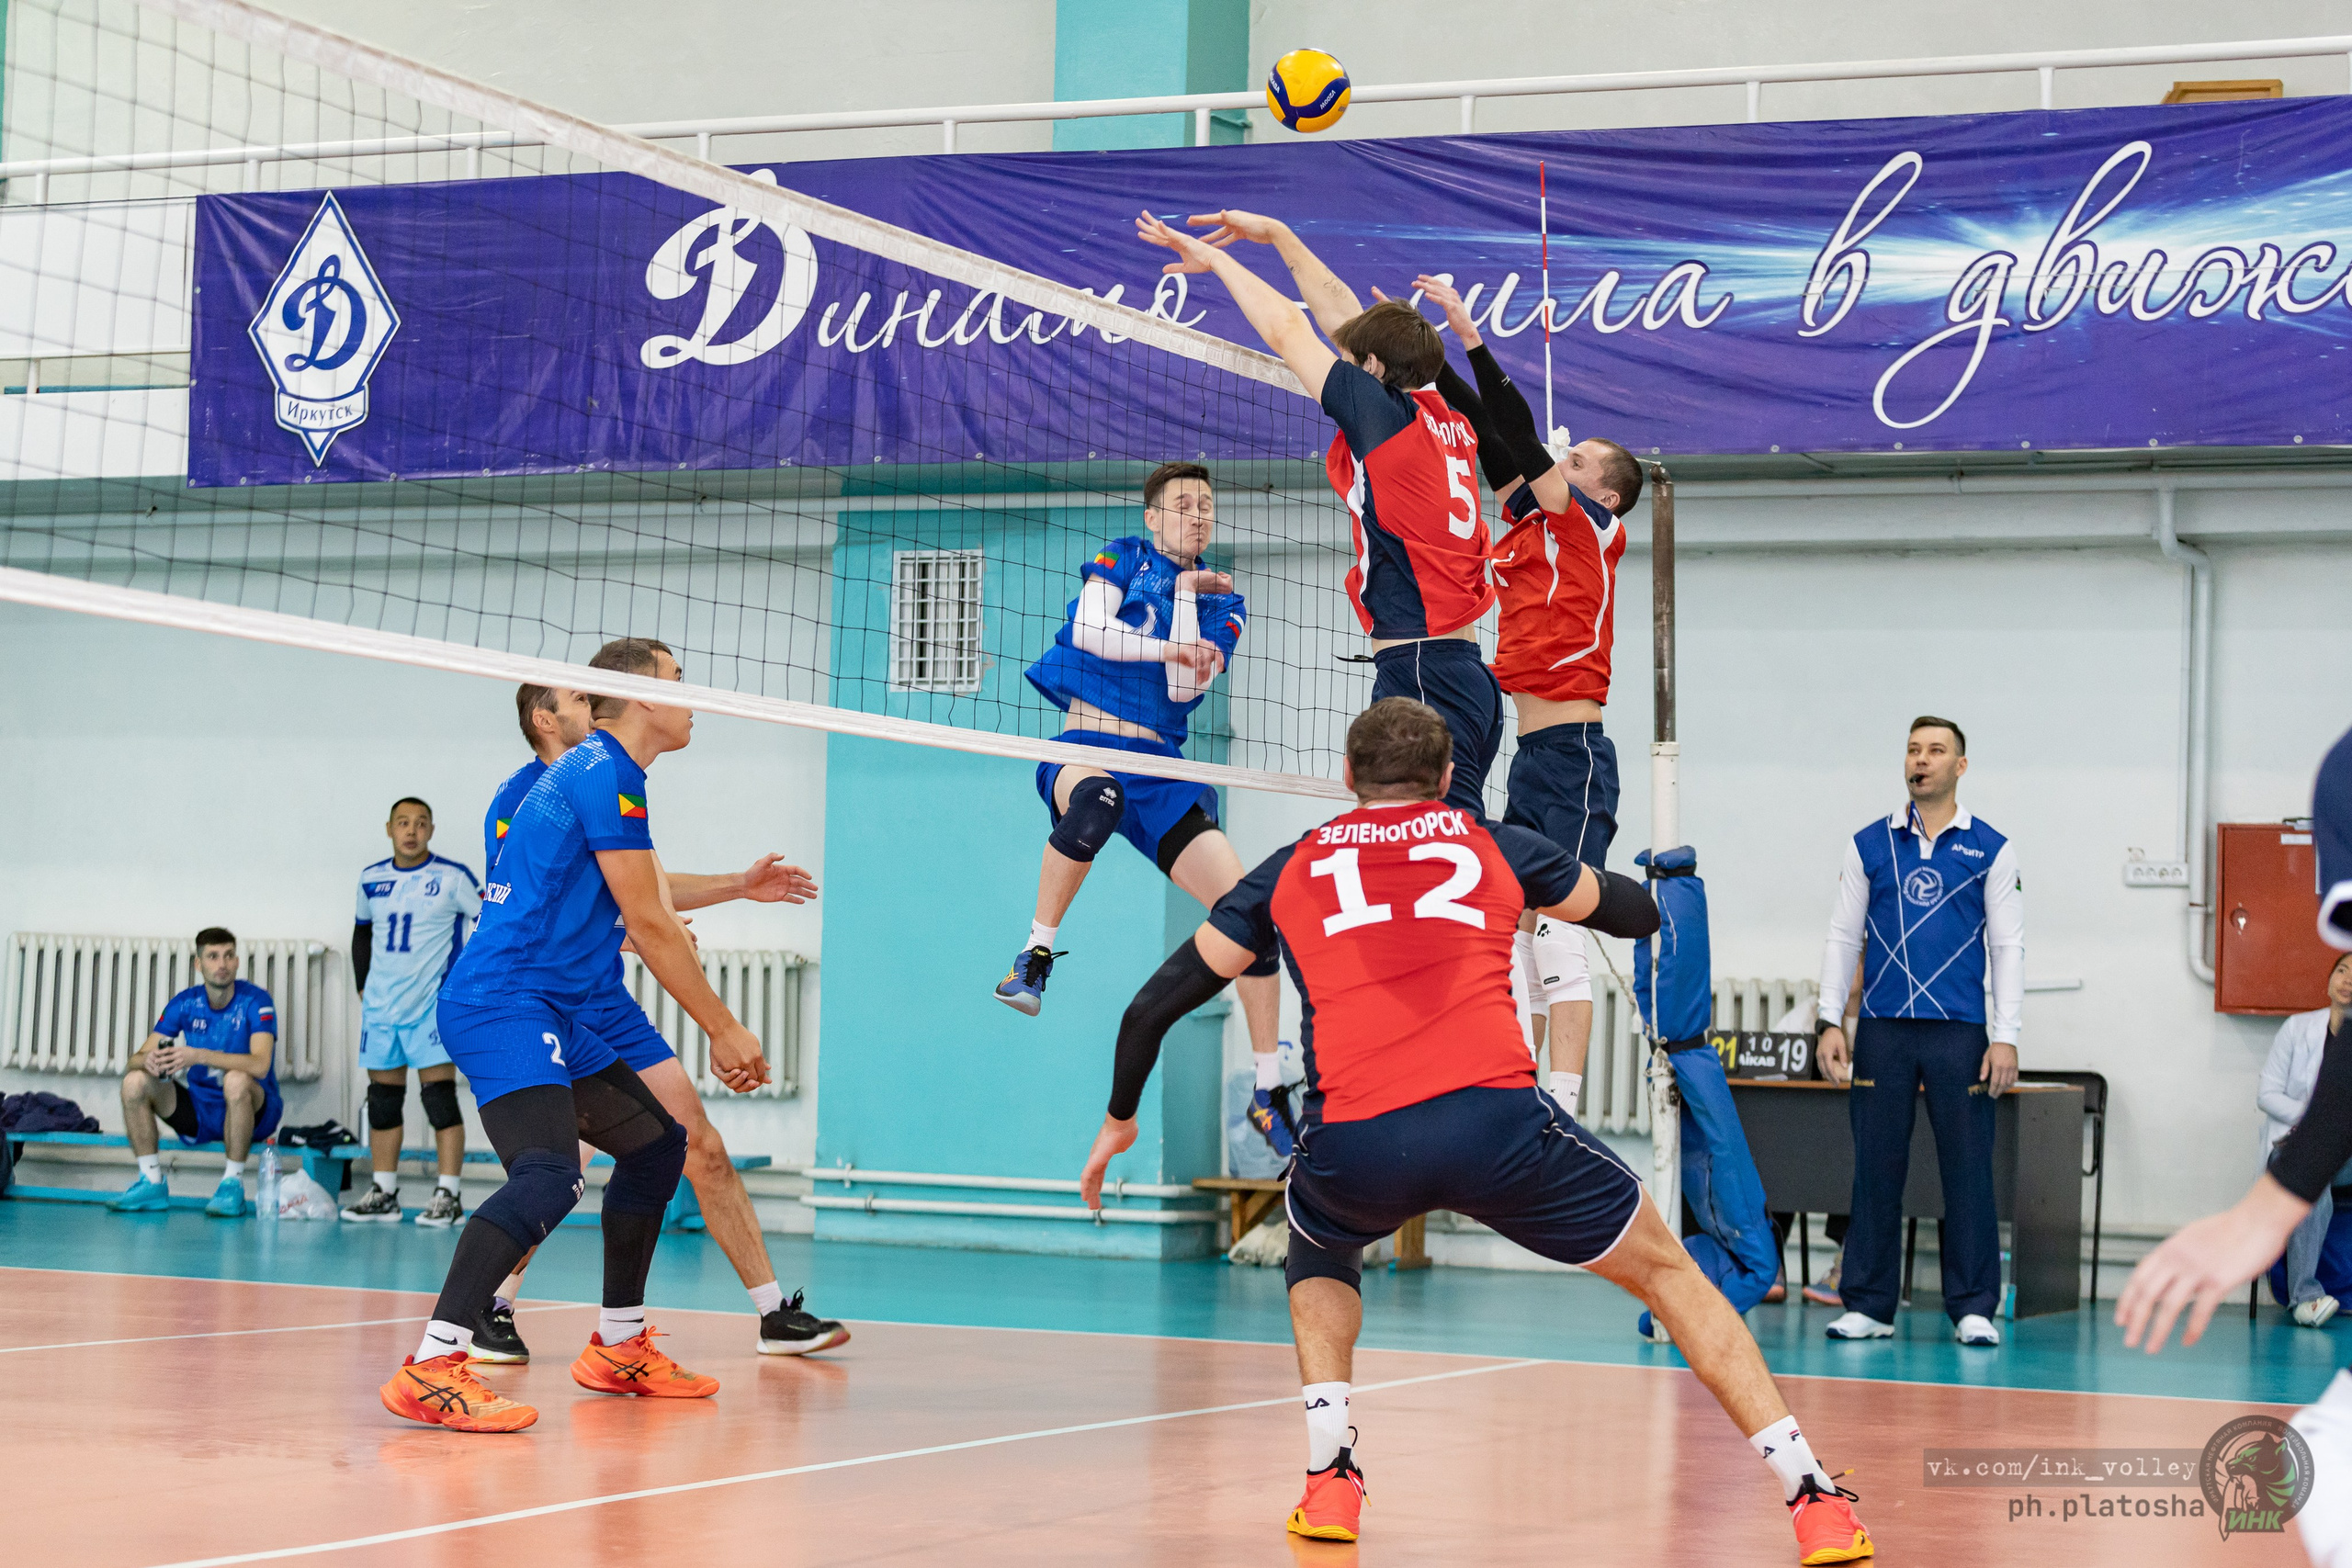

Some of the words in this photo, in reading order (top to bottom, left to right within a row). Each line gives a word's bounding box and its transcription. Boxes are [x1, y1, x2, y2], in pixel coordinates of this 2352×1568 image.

[1796, 150, 1924, 338] в
[1872, 141, 2352, 429] движ
[288, 400, 354, 426] Иркутск
[1444, 453, 1476, 540] 5
[1317, 810, 1470, 845] ЗЕЛЕНОГОРСК
[1951, 842, 1984, 859] АРБИТР
[1310, 841, 1486, 938] 12
[386, 912, 413, 952] 11
[541, 1031, 567, 1067] 2
[1711, 1035, 1738, 1069] 21
[1747, 1035, 1757, 1052] 1
[1761, 1036, 1773, 1053] 0
[1778, 1038, 1808, 1073] 19
